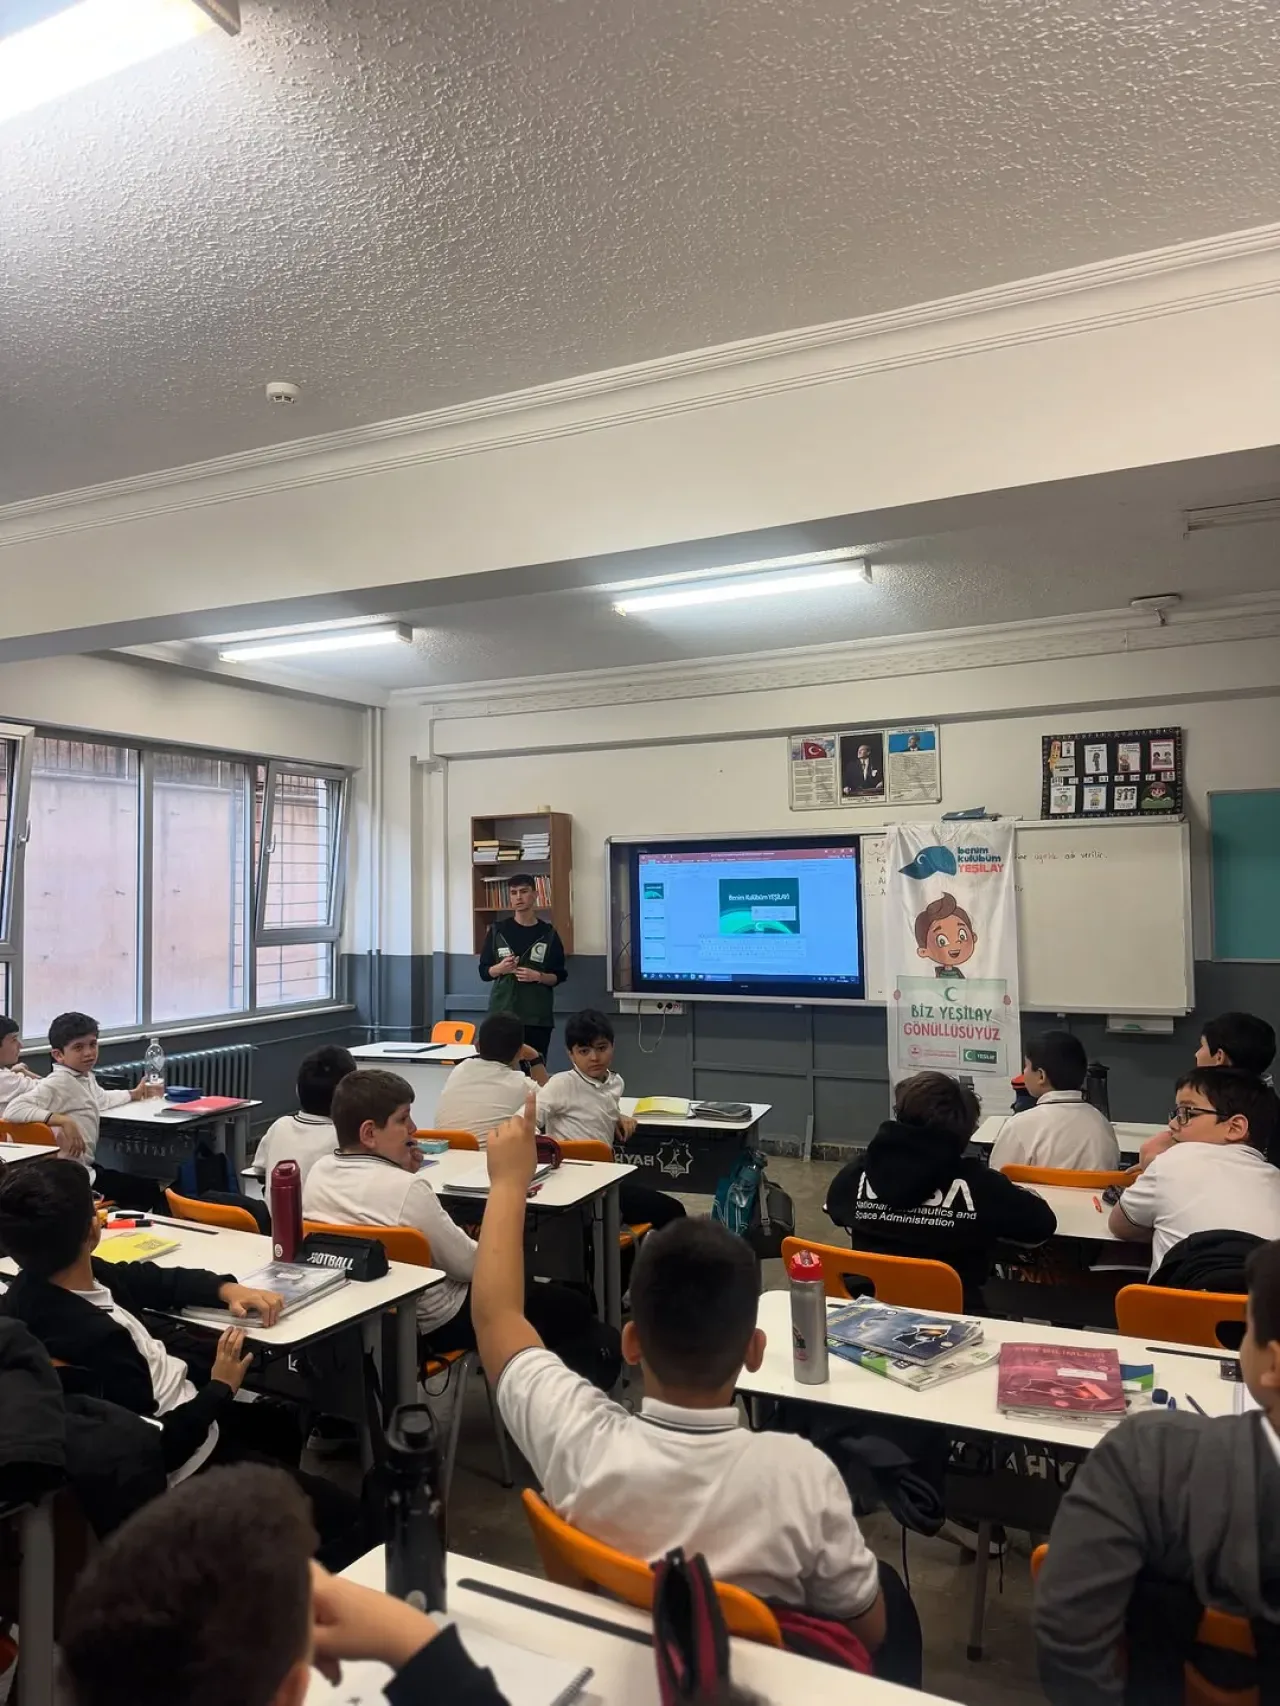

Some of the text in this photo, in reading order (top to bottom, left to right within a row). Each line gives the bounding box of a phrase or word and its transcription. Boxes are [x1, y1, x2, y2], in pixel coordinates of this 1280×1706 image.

[957, 846, 989, 854] benim
[911, 1003, 993, 1022] BİZ YEŞİLAY
[903, 1021, 1001, 1041] GÖNÜLLÜSÜYÜZ
[855, 1210, 955, 1228] Space Administration
[956, 1211, 977, 1220] and
